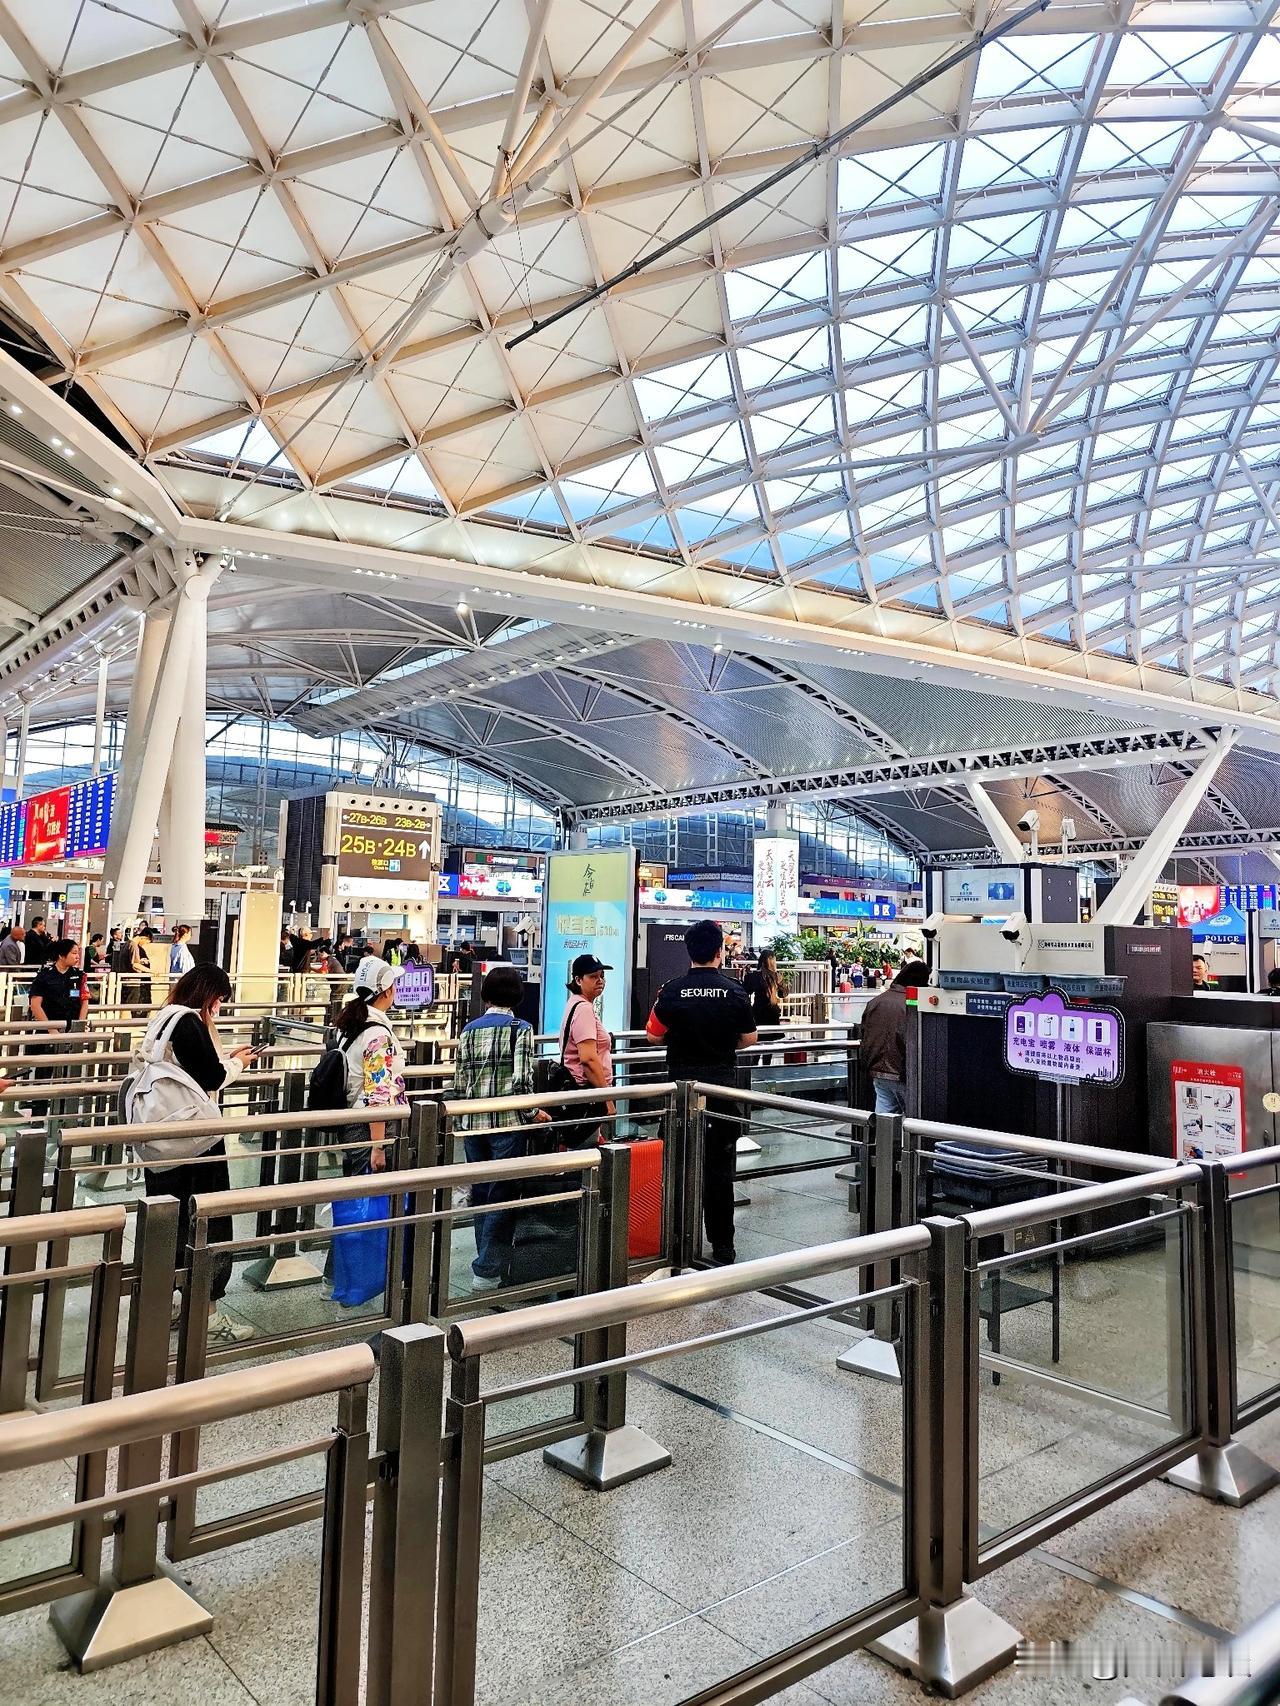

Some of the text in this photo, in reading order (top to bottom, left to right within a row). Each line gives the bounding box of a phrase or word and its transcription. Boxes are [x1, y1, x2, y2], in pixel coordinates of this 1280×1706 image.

[1205, 934, 1240, 942] POLICE
[680, 988, 728, 998] SECURITY
[1012, 1036, 1113, 1058] 充电宝 喷雾 液体 保温杯
